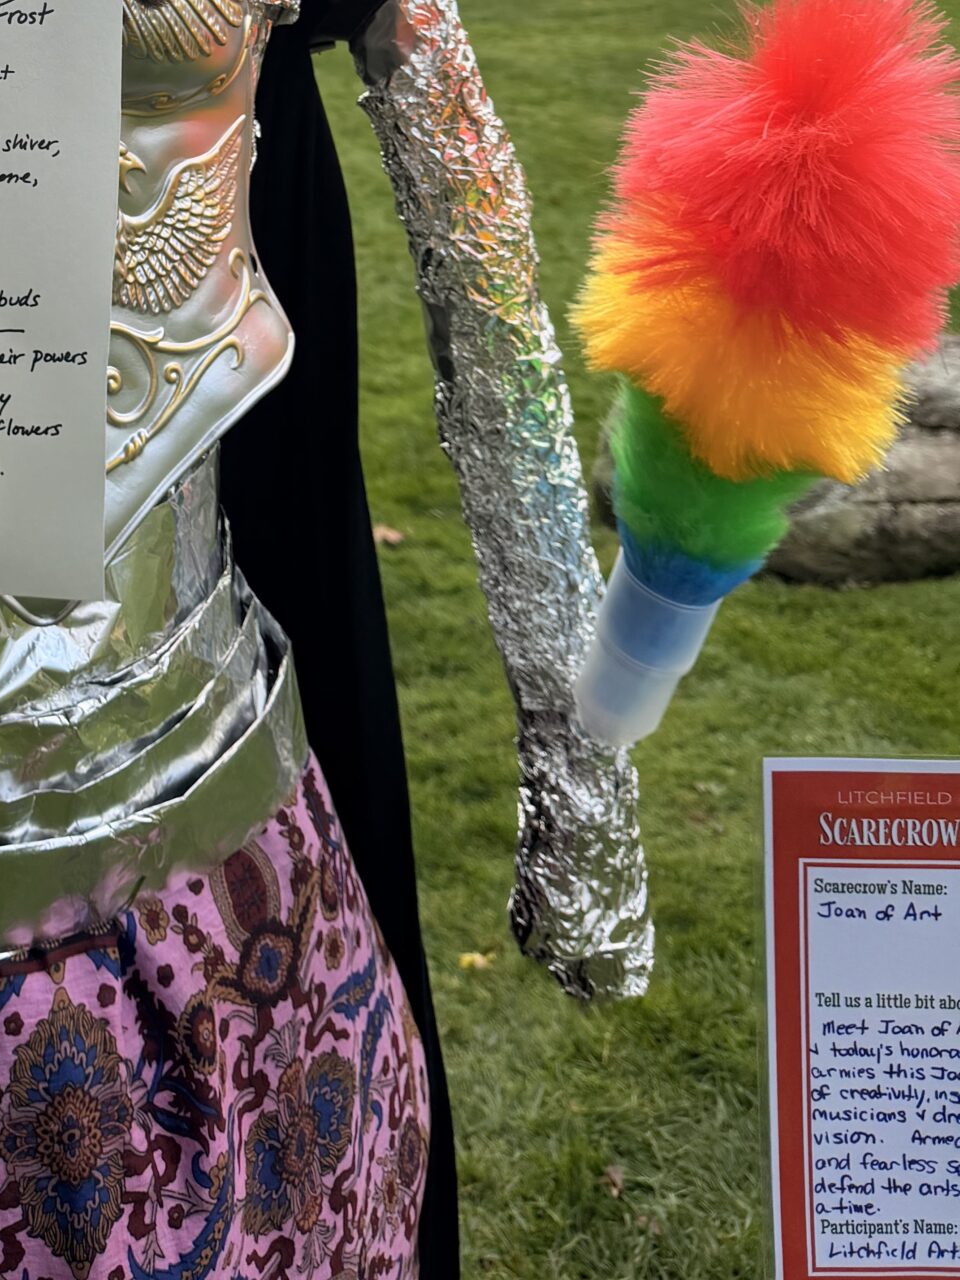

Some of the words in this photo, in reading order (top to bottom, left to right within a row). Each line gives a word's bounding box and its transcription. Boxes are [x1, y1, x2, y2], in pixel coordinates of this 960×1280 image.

[2, 133, 61, 158] shiver,
[31, 350, 88, 372] powers
[837, 790, 952, 805] LITCHFIELD
[819, 812, 960, 847] SCARECROW
[813, 878, 898, 894] Scarecrow's
[901, 880, 948, 896] Name:
[817, 901, 867, 919] Joan
[875, 904, 895, 921] of
[904, 902, 942, 921] Art
[815, 992, 841, 1008] Tell
[844, 997, 861, 1008] us
[865, 996, 873, 1008] a
[876, 993, 911, 1009] little
[915, 994, 935, 1009] bit
[822, 1018, 869, 1036] Meet
[878, 1020, 925, 1035] Joan
[931, 1021, 952, 1037] of
[830, 1040, 893, 1064] today's
[811, 1066, 876, 1080] armies
[883, 1063, 926, 1080] this
[810, 1084, 831, 1102] of
[812, 1107, 907, 1123] musicians
[813, 1129, 884, 1145] vision.
[815, 1152, 850, 1170] and
[860, 1152, 938, 1174] fearless
[814, 1174, 875, 1195] defend
[881, 1177, 912, 1196] the
[815, 1202, 831, 1215] a
[831, 1197, 880, 1216] time.
[821, 1219, 909, 1238] Participant's
[913, 1219, 958, 1235] Name:
[828, 1240, 917, 1260] Litchfield
[927, 1241, 960, 1260] Art
